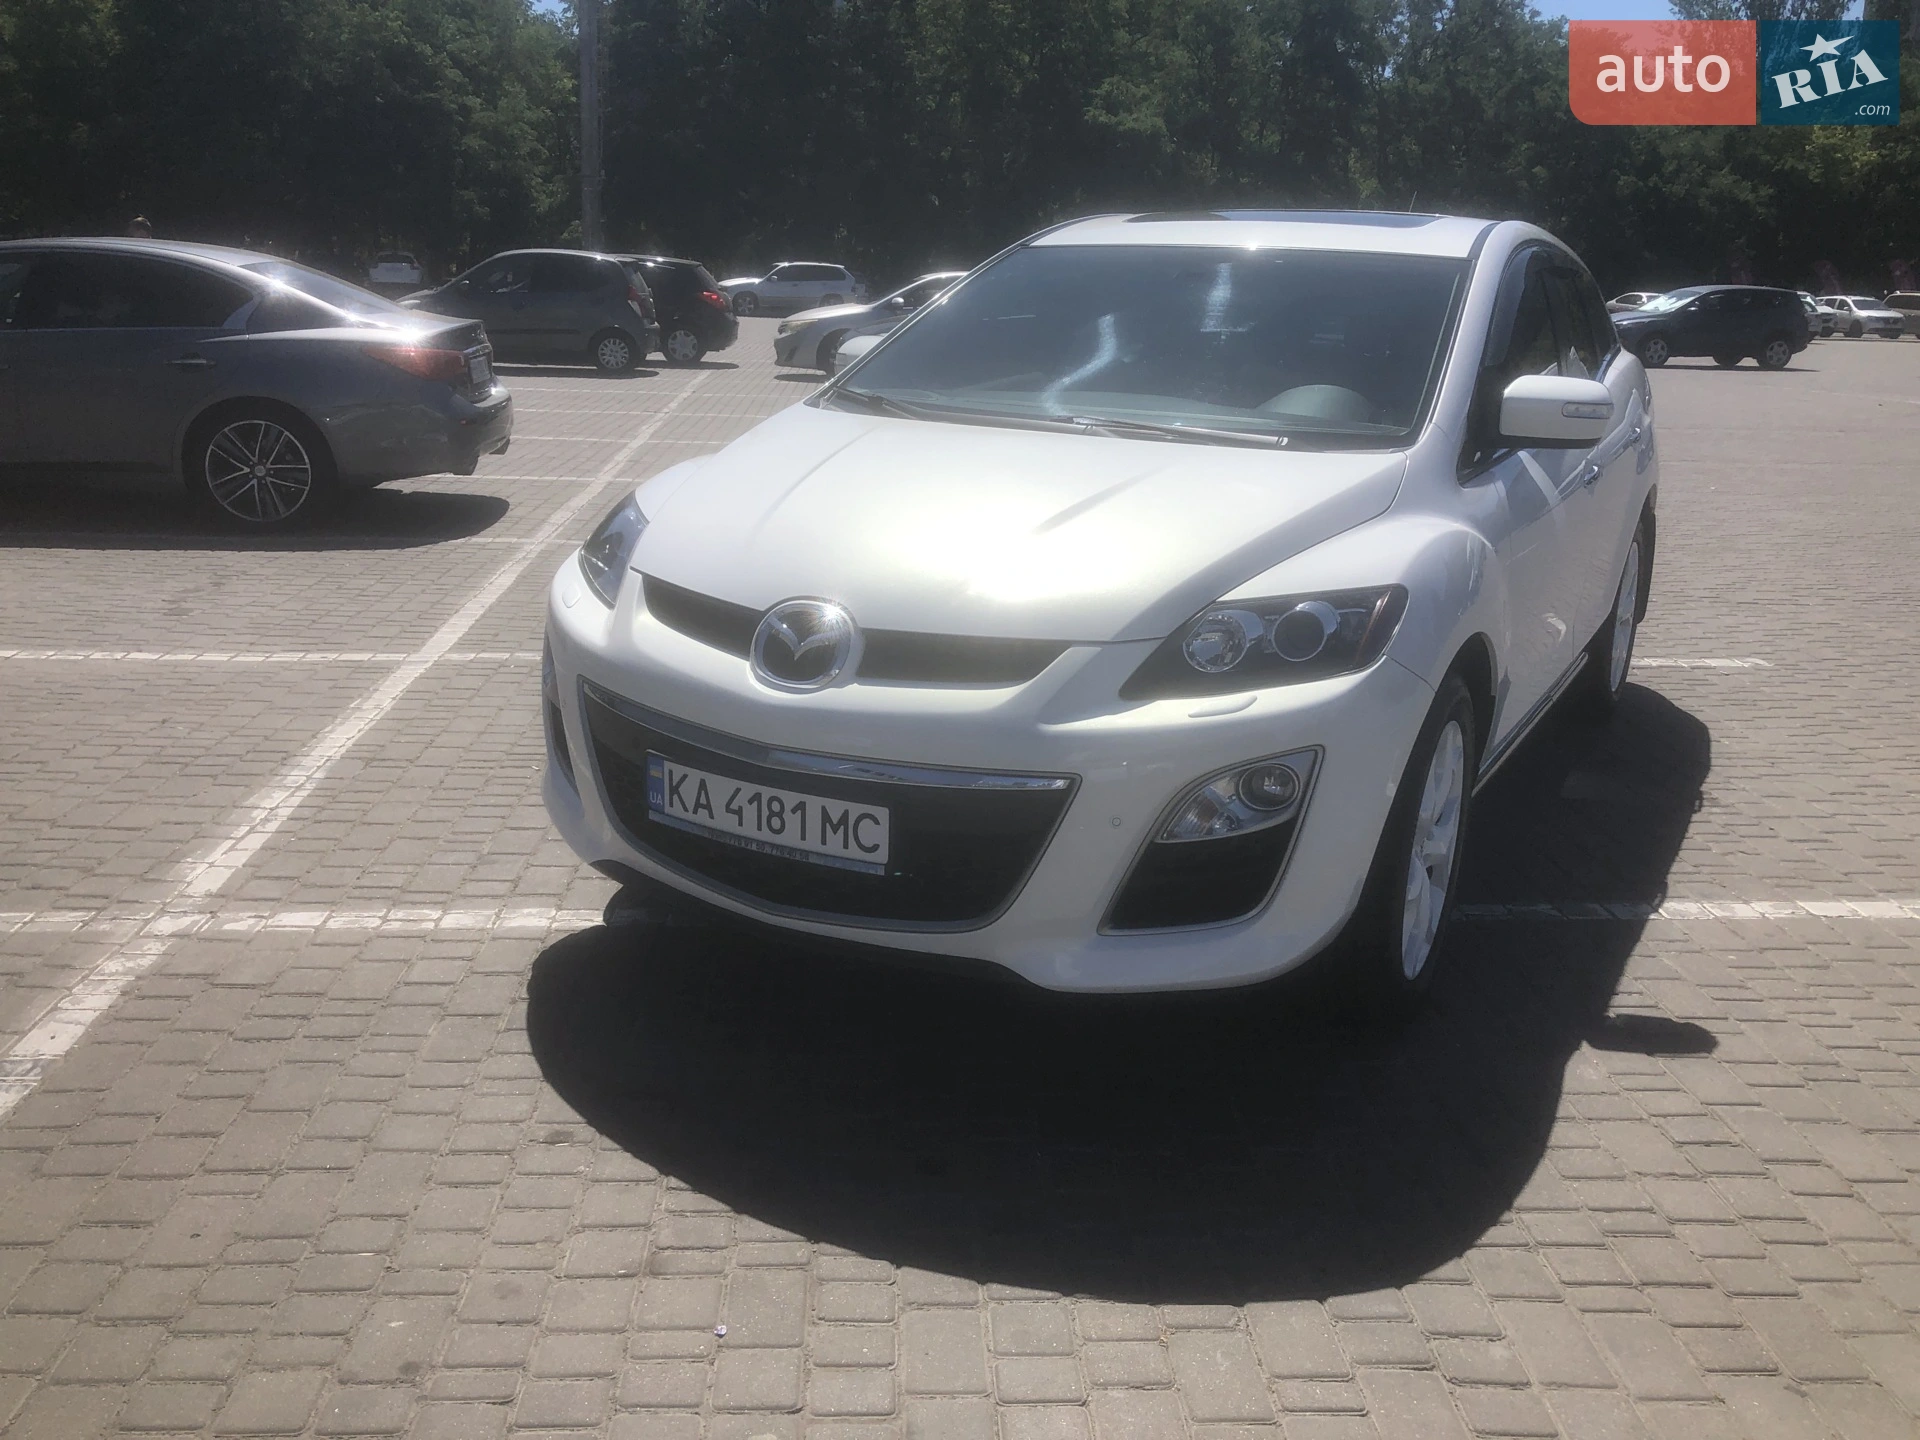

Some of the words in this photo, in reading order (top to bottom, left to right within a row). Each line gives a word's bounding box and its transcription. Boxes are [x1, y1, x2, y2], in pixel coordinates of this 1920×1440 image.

[649, 791, 663, 806] UA
[668, 769, 715, 820] KA
[725, 787, 808, 842] 4181
[820, 805, 881, 854] MC
